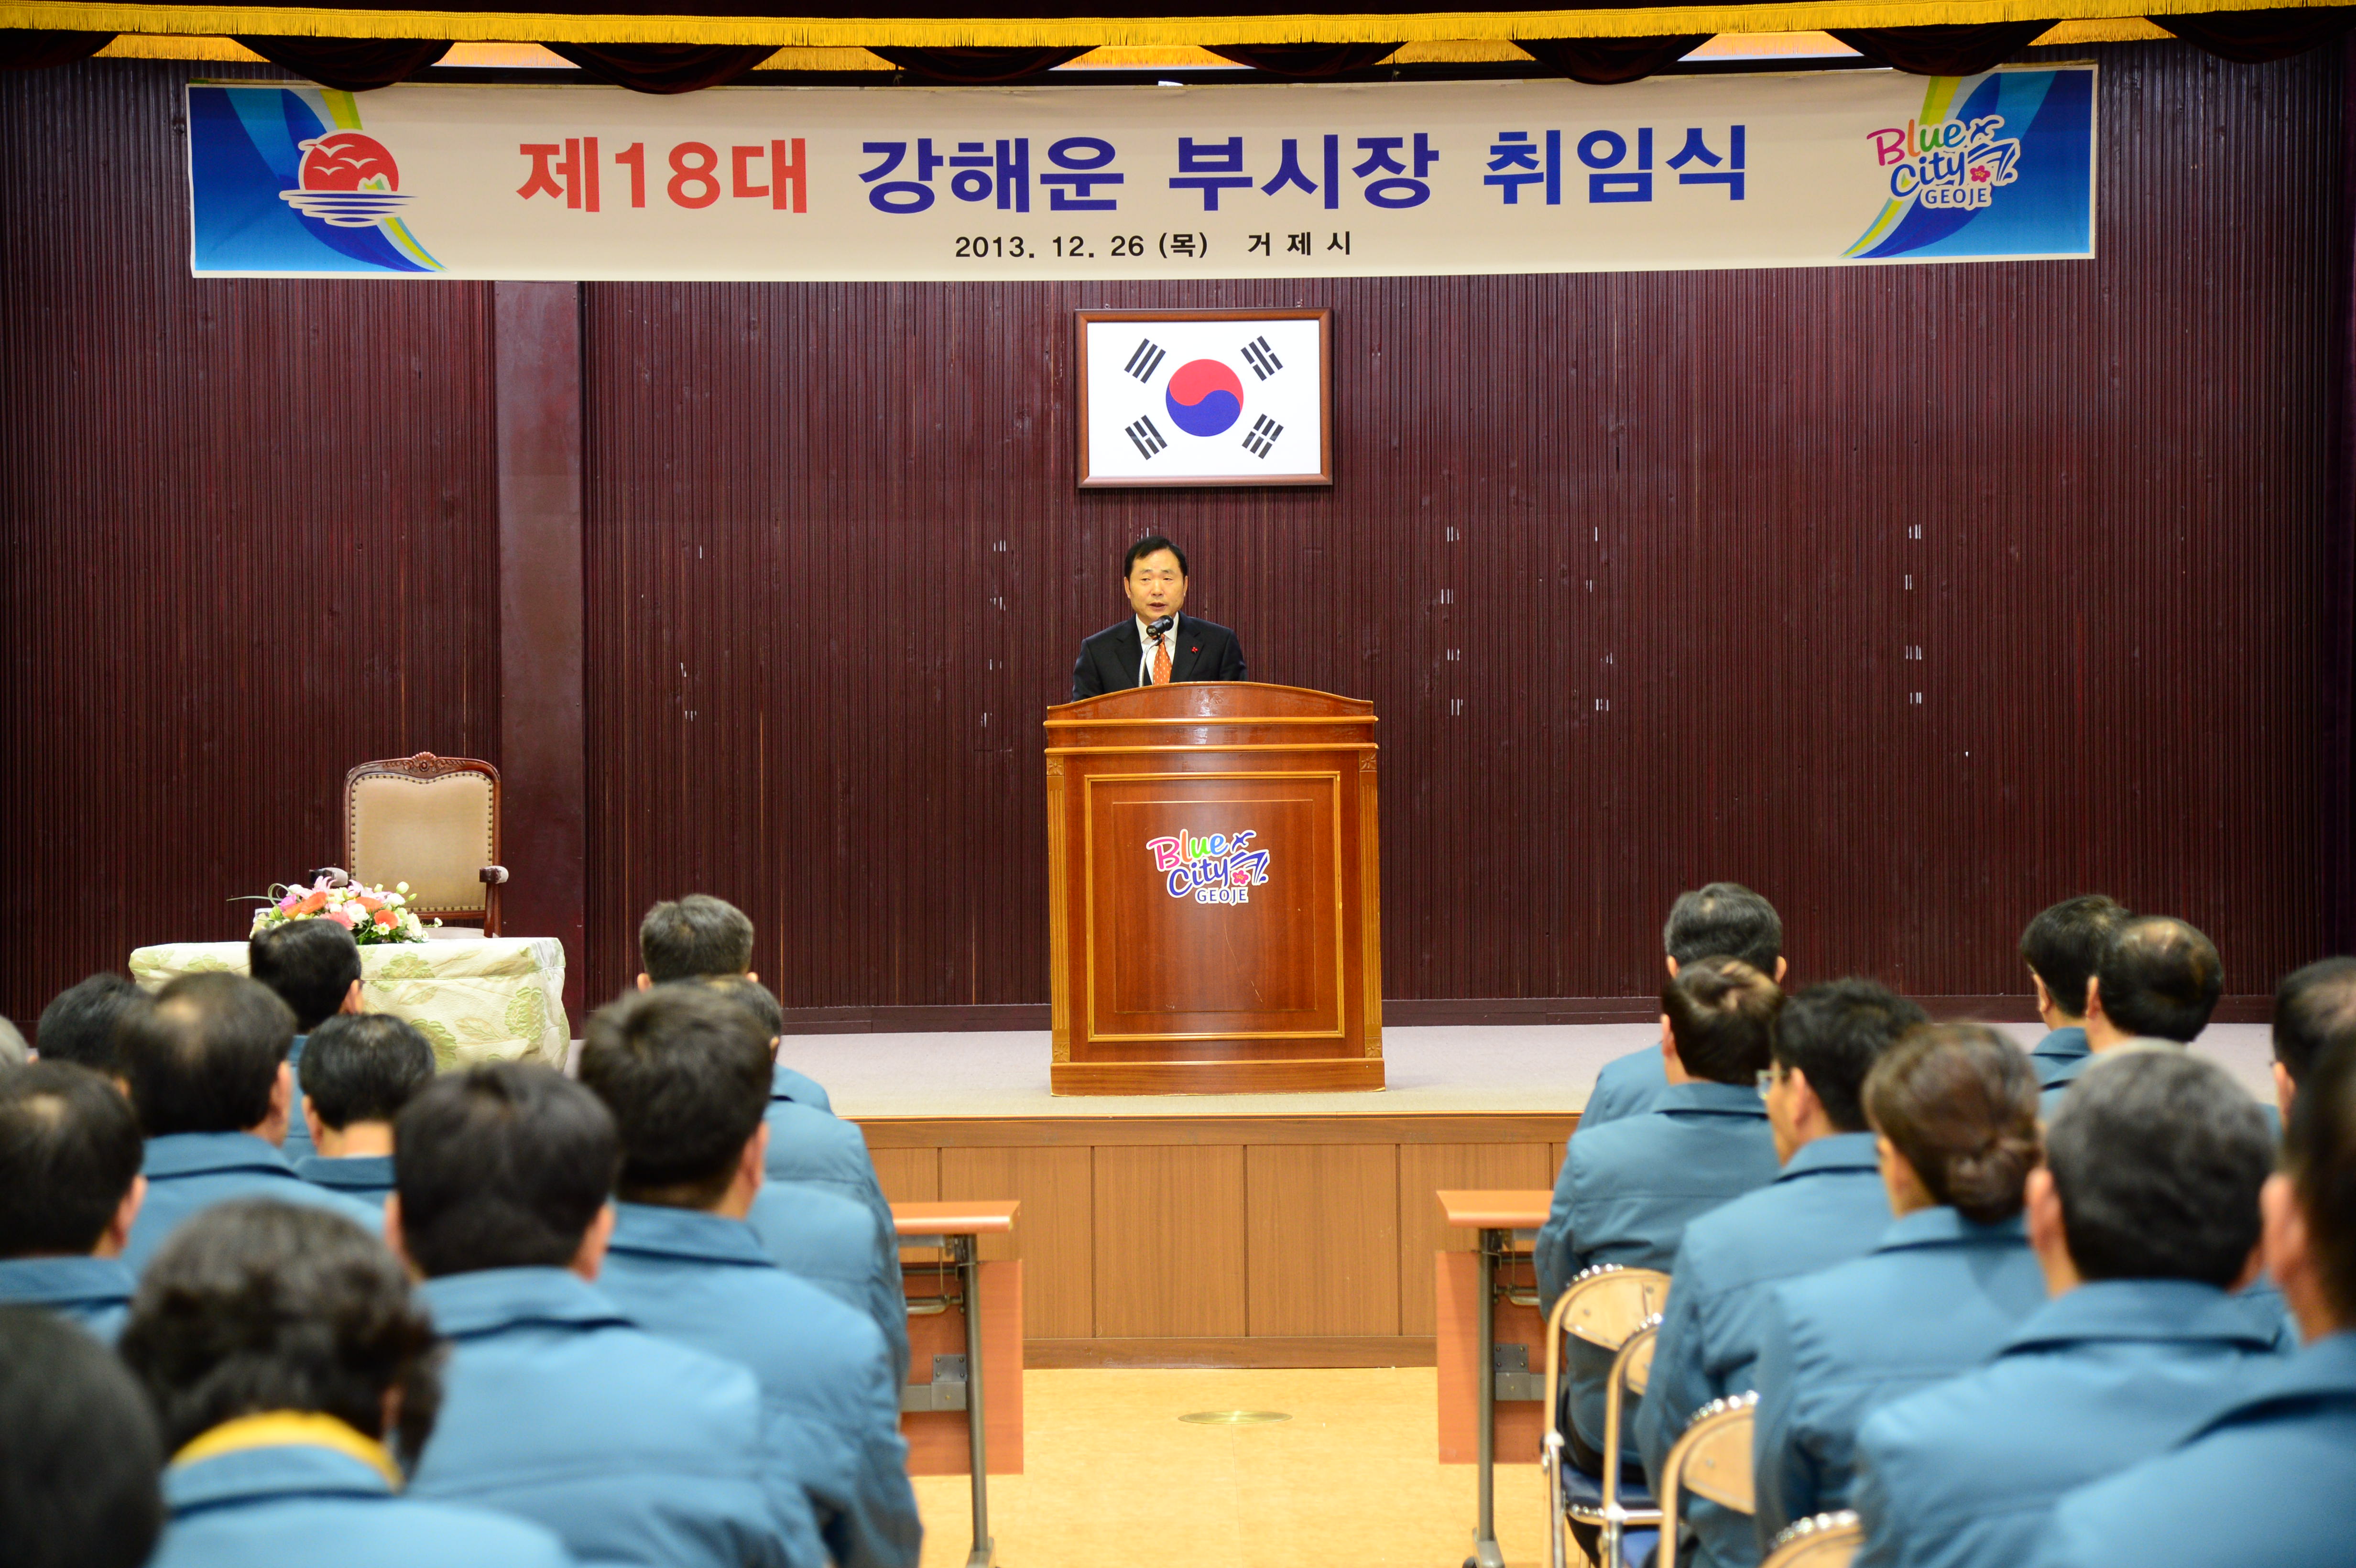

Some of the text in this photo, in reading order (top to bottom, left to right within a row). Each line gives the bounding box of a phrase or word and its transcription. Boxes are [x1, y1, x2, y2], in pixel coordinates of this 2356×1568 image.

[1866, 119, 1966, 166] Blue
[516, 125, 1745, 214] 제18대 강해운 부시장 취임식
[1890, 151, 1966, 197] City
[1925, 187, 1987, 206] GEOJE
[955, 236, 1035, 258] 2013.
[1052, 236, 1094, 258] 12.
[1111, 235, 1144, 256] 26
[1159, 232, 1207, 259] (목)
[1148, 830, 1229, 870] Blue
[1169, 859, 1228, 896] City
[1197, 889, 1247, 904] GEOJE
